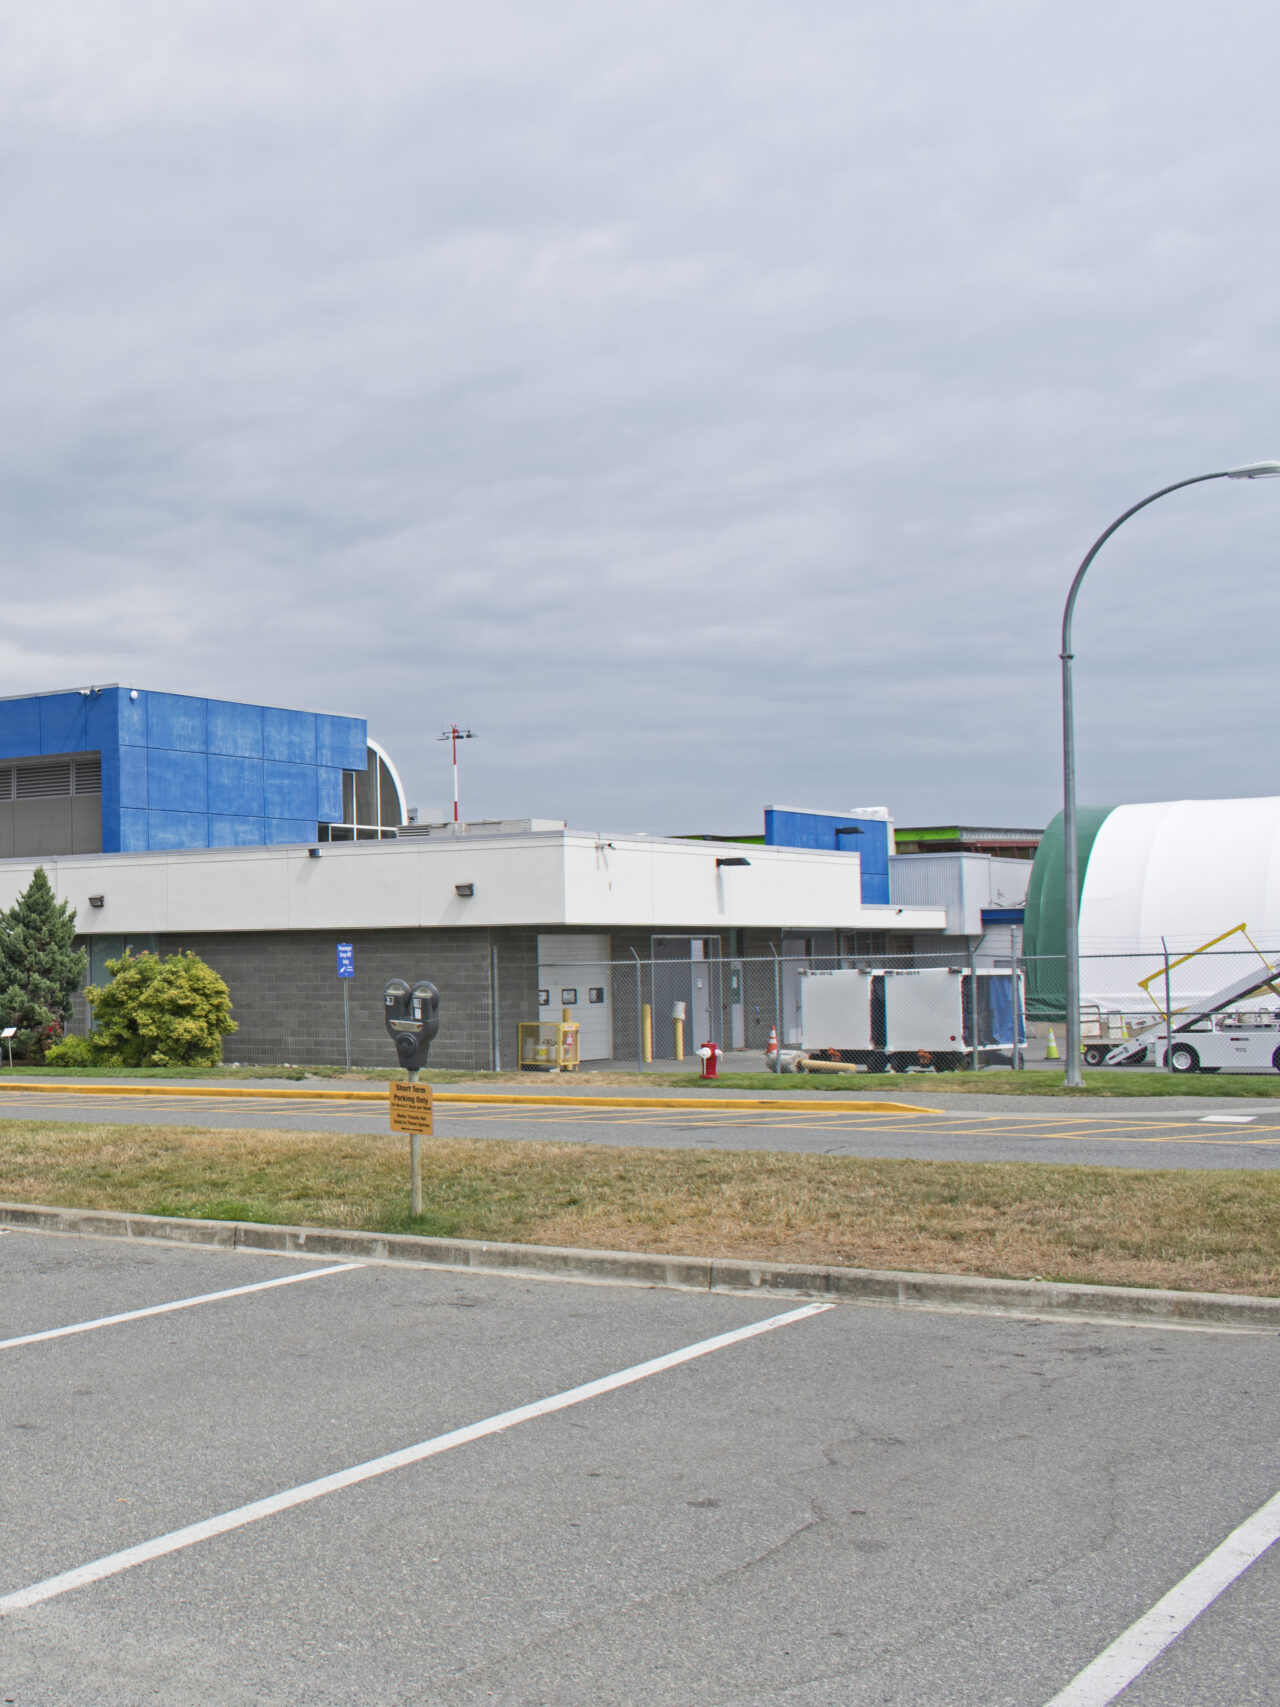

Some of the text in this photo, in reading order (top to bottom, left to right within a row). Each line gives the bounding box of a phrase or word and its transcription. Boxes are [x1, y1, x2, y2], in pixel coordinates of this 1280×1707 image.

[396, 1084, 426, 1094] Short Term
[393, 1093, 429, 1105] Parking Only
